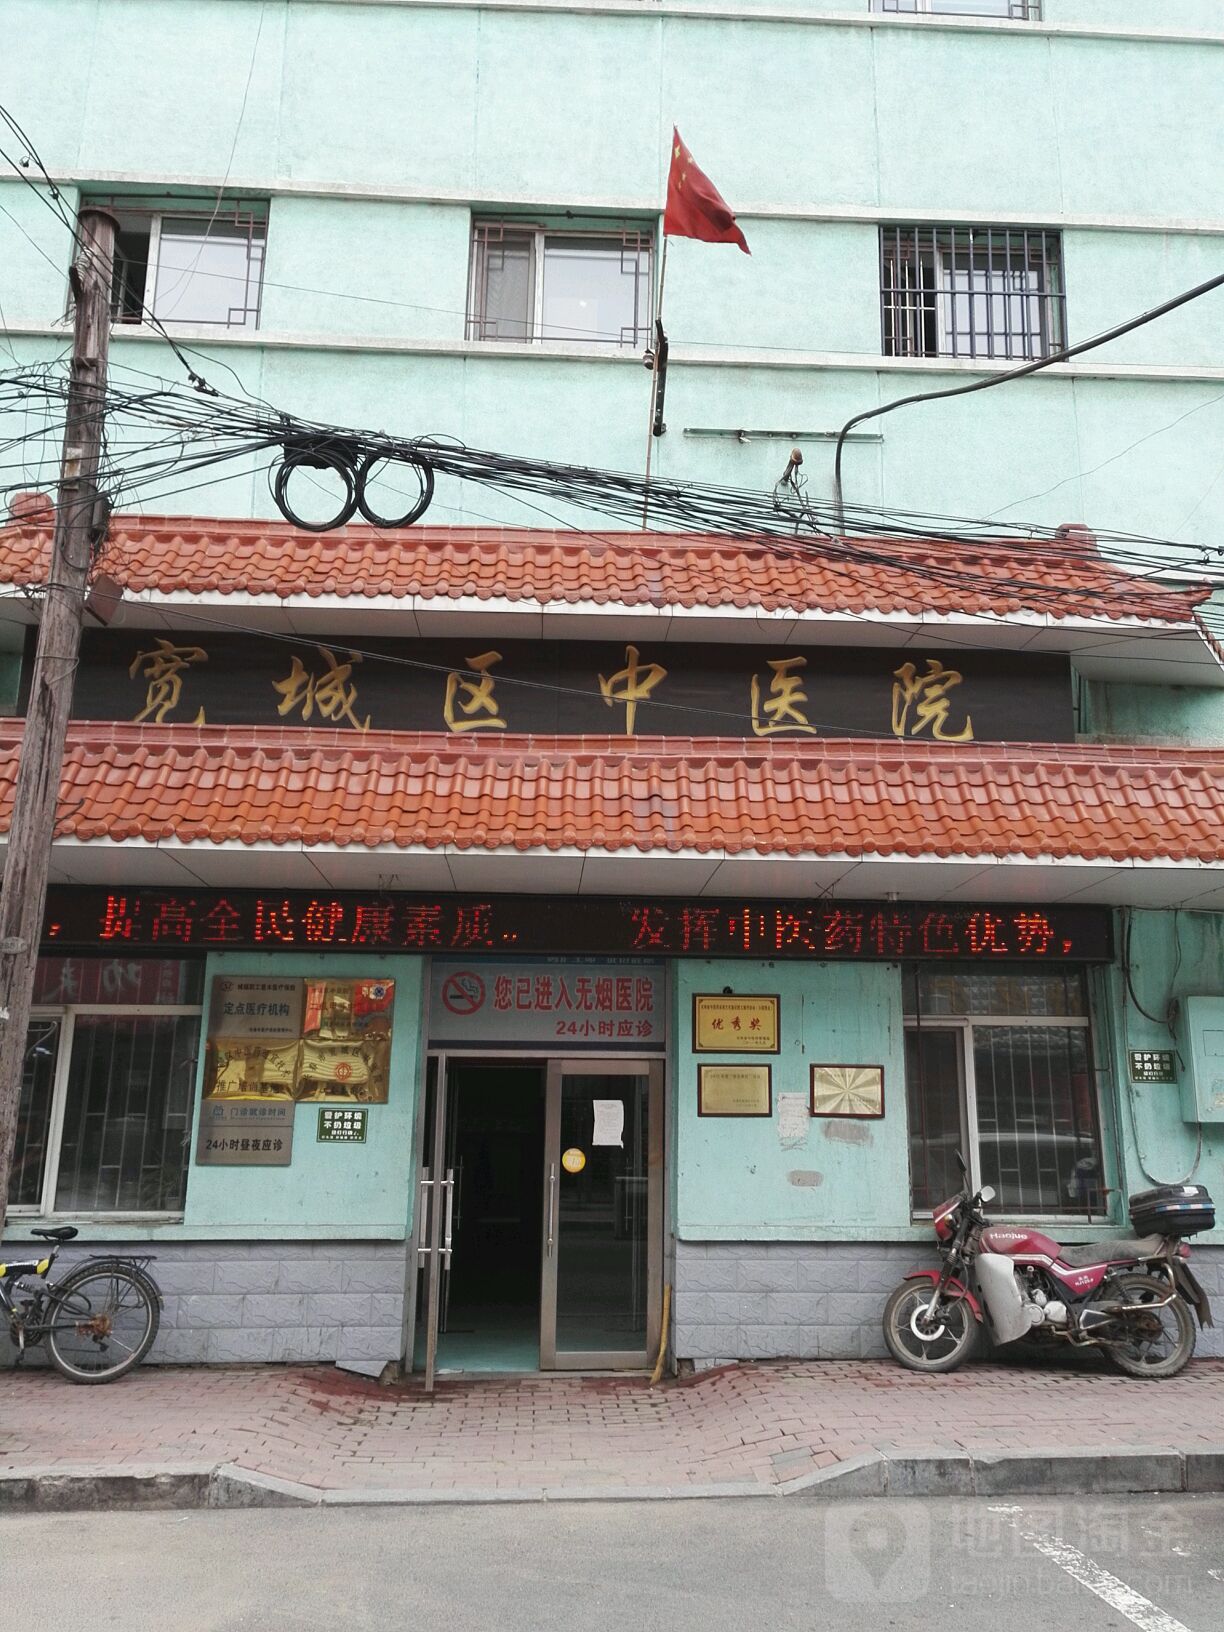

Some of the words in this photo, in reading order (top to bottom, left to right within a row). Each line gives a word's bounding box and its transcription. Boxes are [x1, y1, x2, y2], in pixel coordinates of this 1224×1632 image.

[129, 638, 974, 742] 宽城区中医院
[494, 976, 654, 1012] 您已进入无烟医院
[223, 1002, 290, 1017] 定点医疗机构
[555, 1020, 653, 1037] 24小时应诊
[711, 1016, 762, 1031] 优秀奖
[324, 1111, 363, 1120] 爱护环境
[323, 1121, 362, 1129] 不扔垃圾
[206, 1138, 284, 1151] 24小时昼夜应诊
